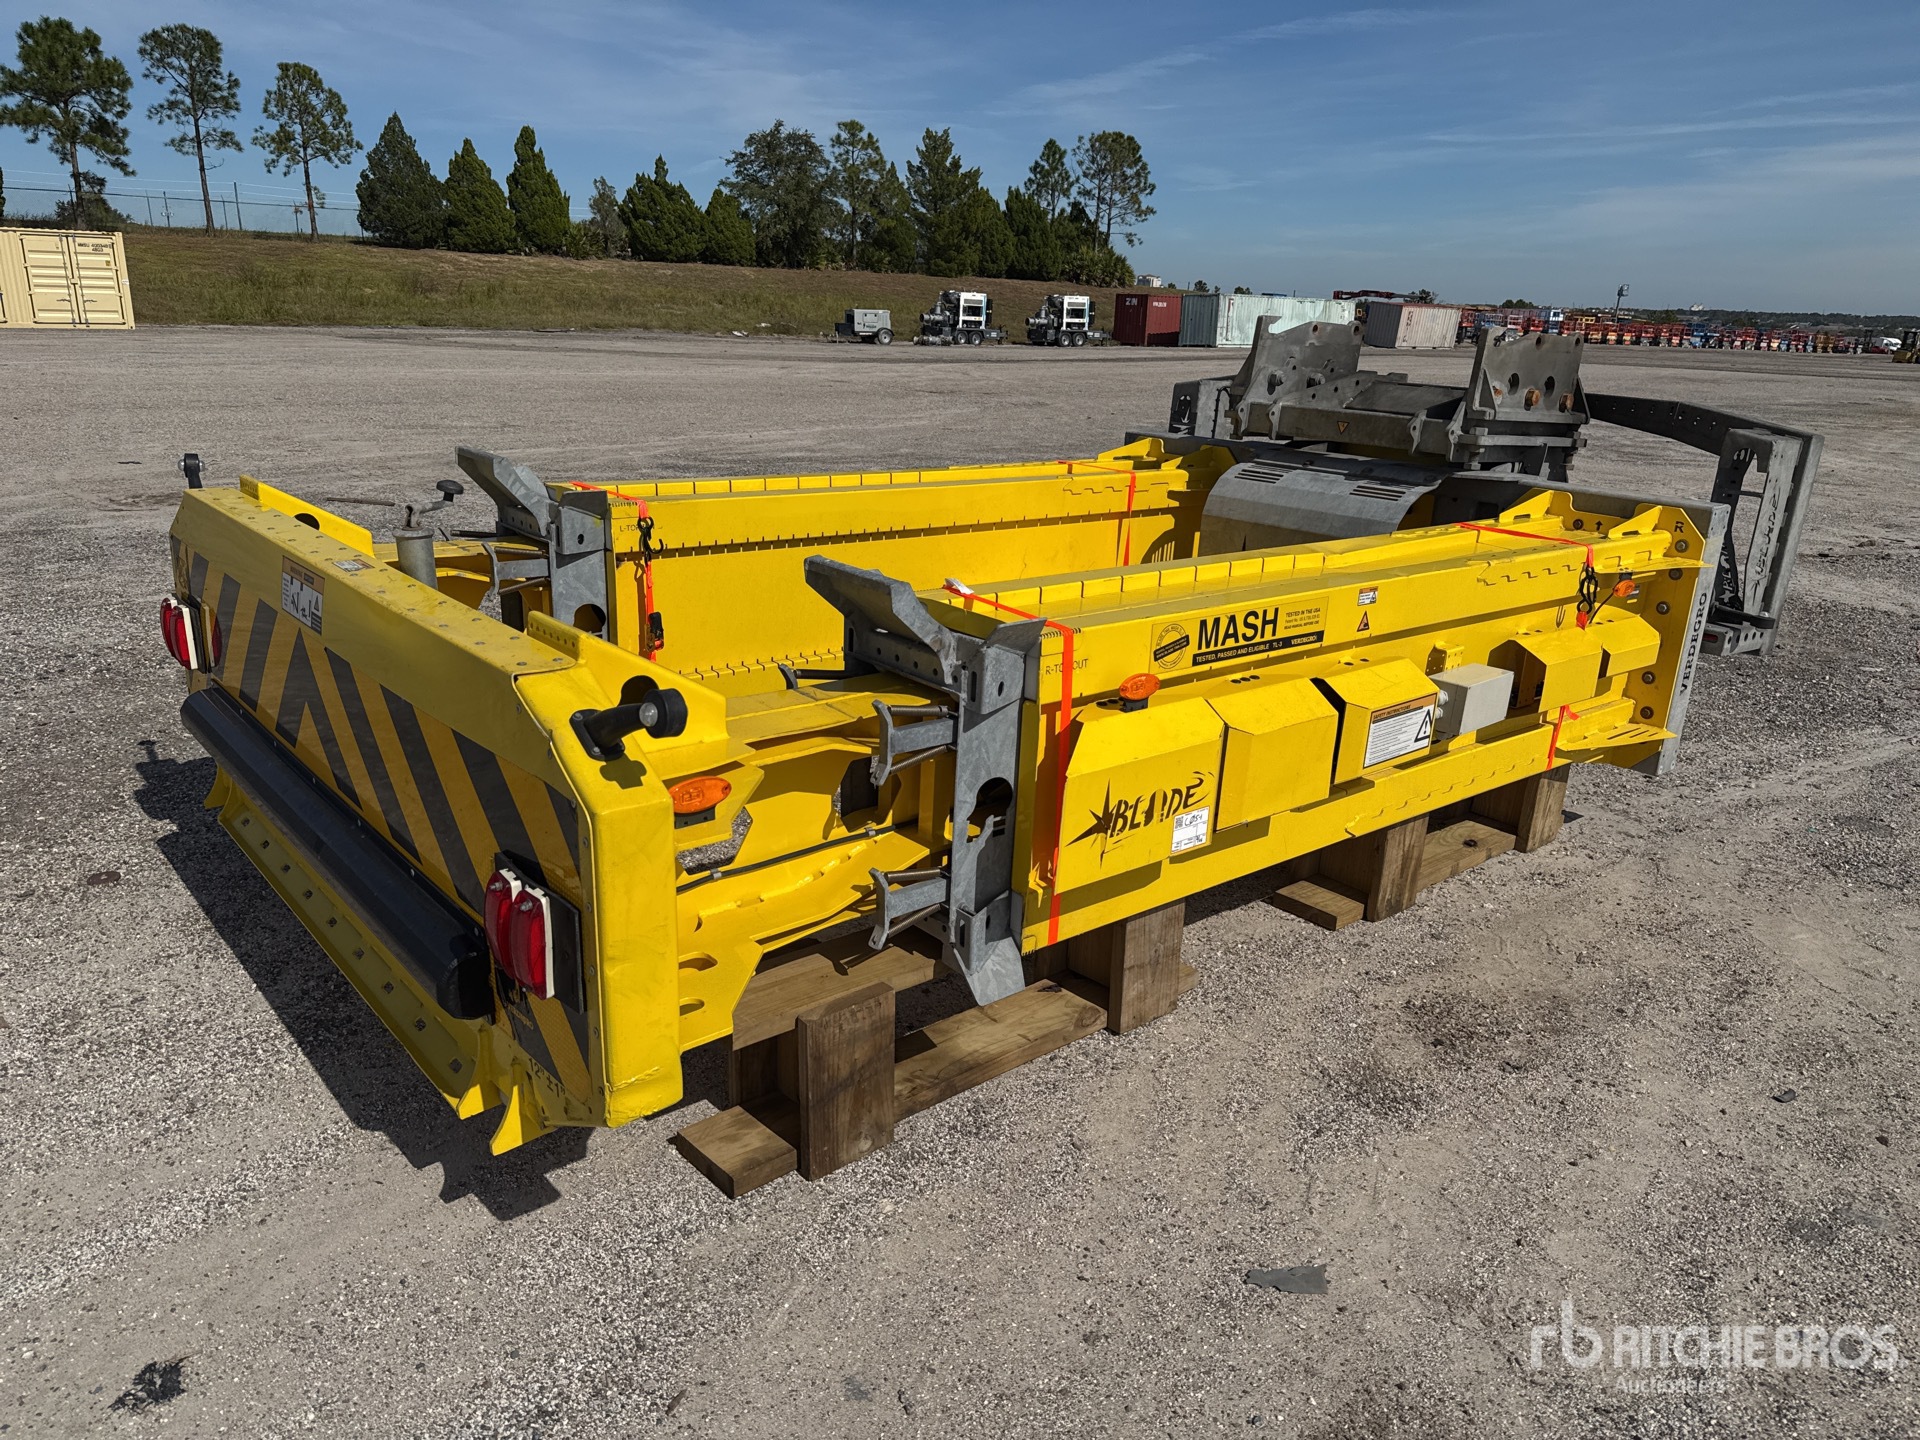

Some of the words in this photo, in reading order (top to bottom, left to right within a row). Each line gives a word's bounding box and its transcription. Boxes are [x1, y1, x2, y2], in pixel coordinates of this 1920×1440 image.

[1674, 521, 1684, 533] R
[1198, 607, 1279, 650] MASH
[1679, 592, 1707, 696] VERDEGRO
[1196, 654, 1216, 662] TESTED,
[1217, 650, 1237, 658] PASSED
[1248, 643, 1270, 652] ELIGIBLE
[1109, 777, 1206, 838] BLADE
